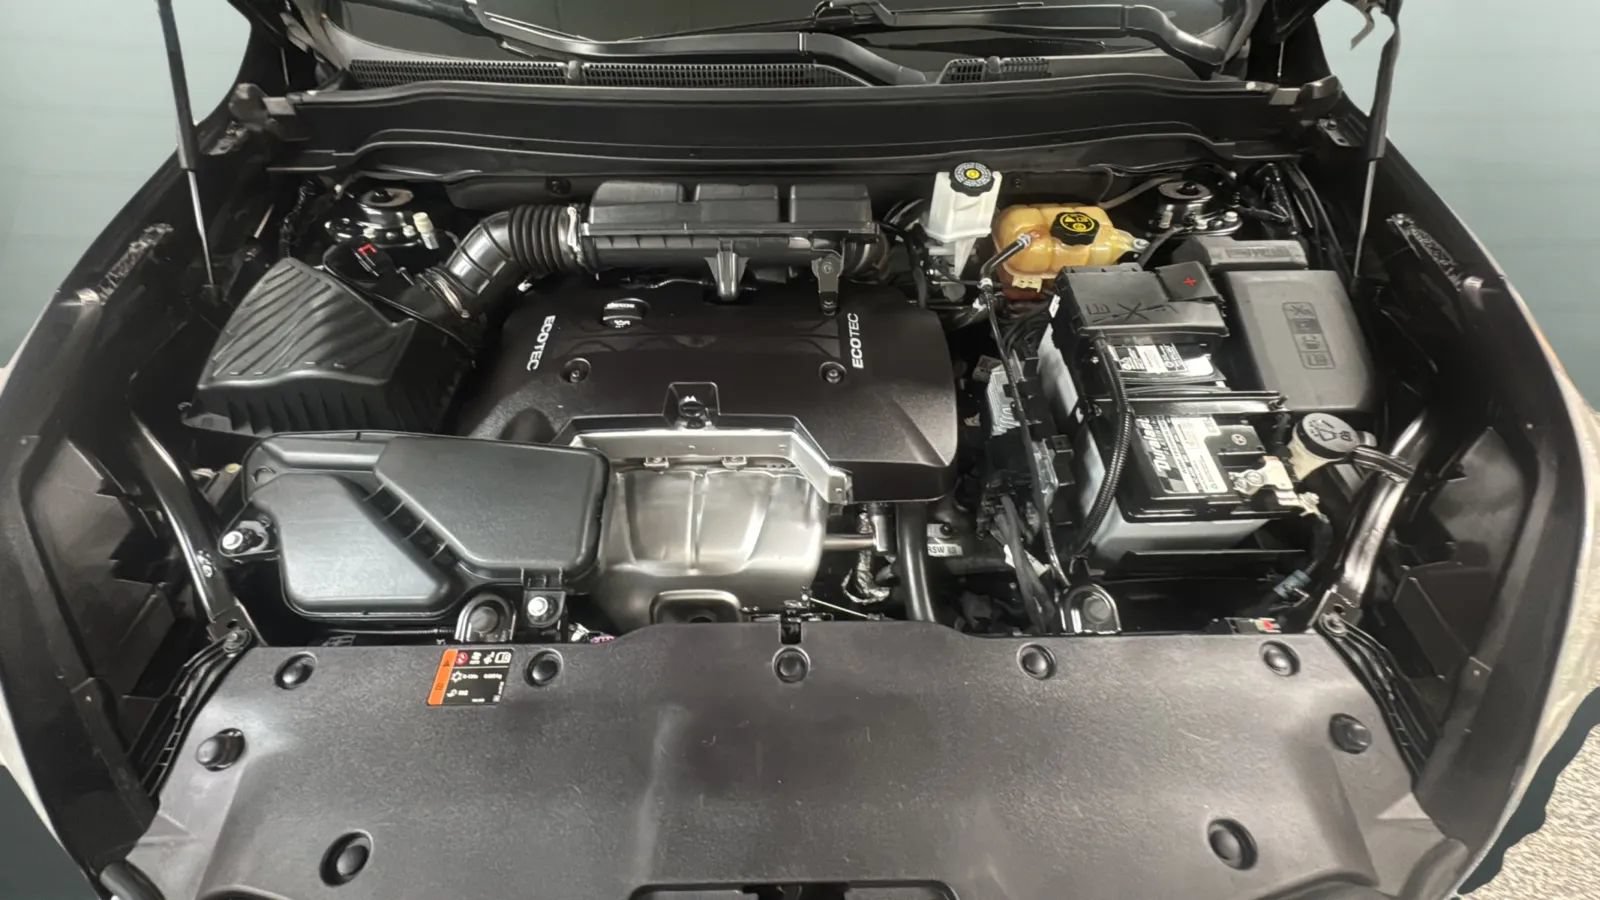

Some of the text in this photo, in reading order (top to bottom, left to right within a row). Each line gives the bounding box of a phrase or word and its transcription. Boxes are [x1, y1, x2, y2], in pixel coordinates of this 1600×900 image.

[526, 315, 556, 371] ECOTEC
[847, 312, 864, 369] ECOTEC
[1135, 418, 1171, 472] Duralast
